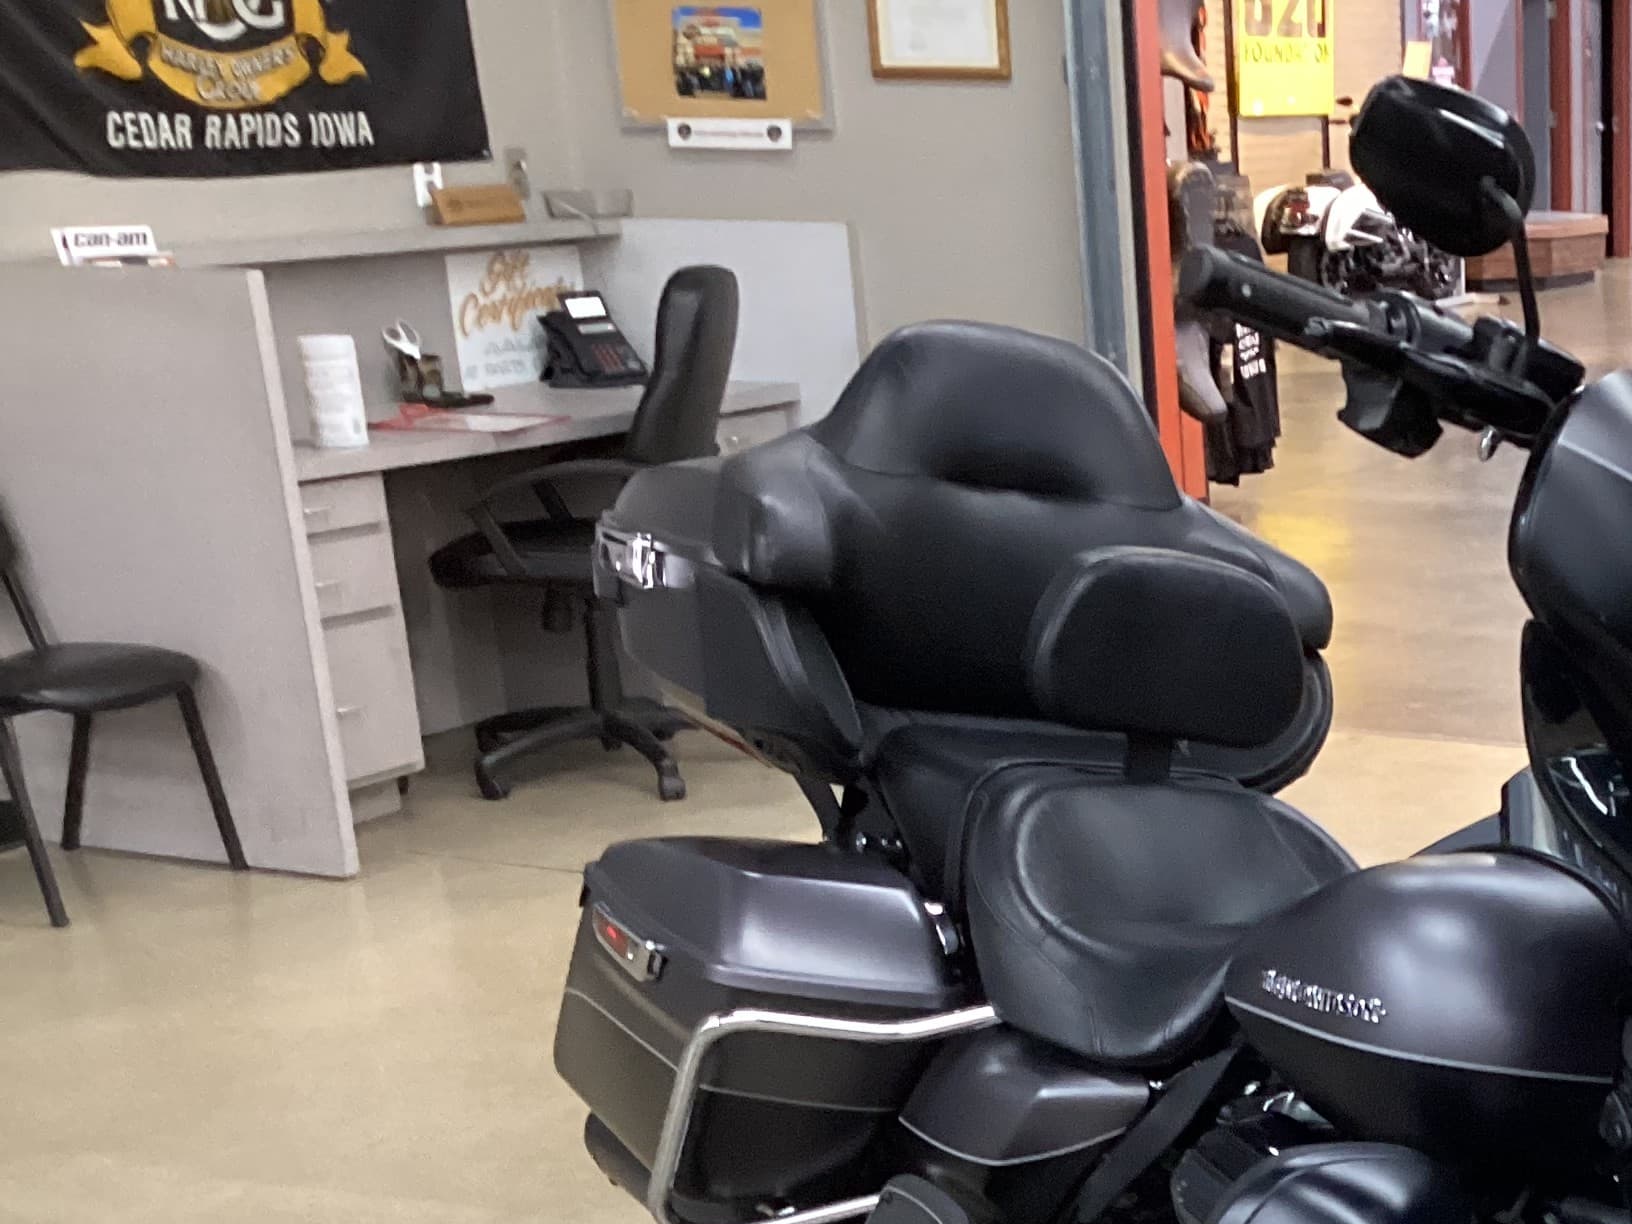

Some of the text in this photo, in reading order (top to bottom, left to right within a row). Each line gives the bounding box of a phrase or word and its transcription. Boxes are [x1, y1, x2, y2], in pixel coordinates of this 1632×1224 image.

[1244, 42, 1330, 63] FOUNDAON
[106, 110, 375, 150] CEDAR RAPIDS IOWA
